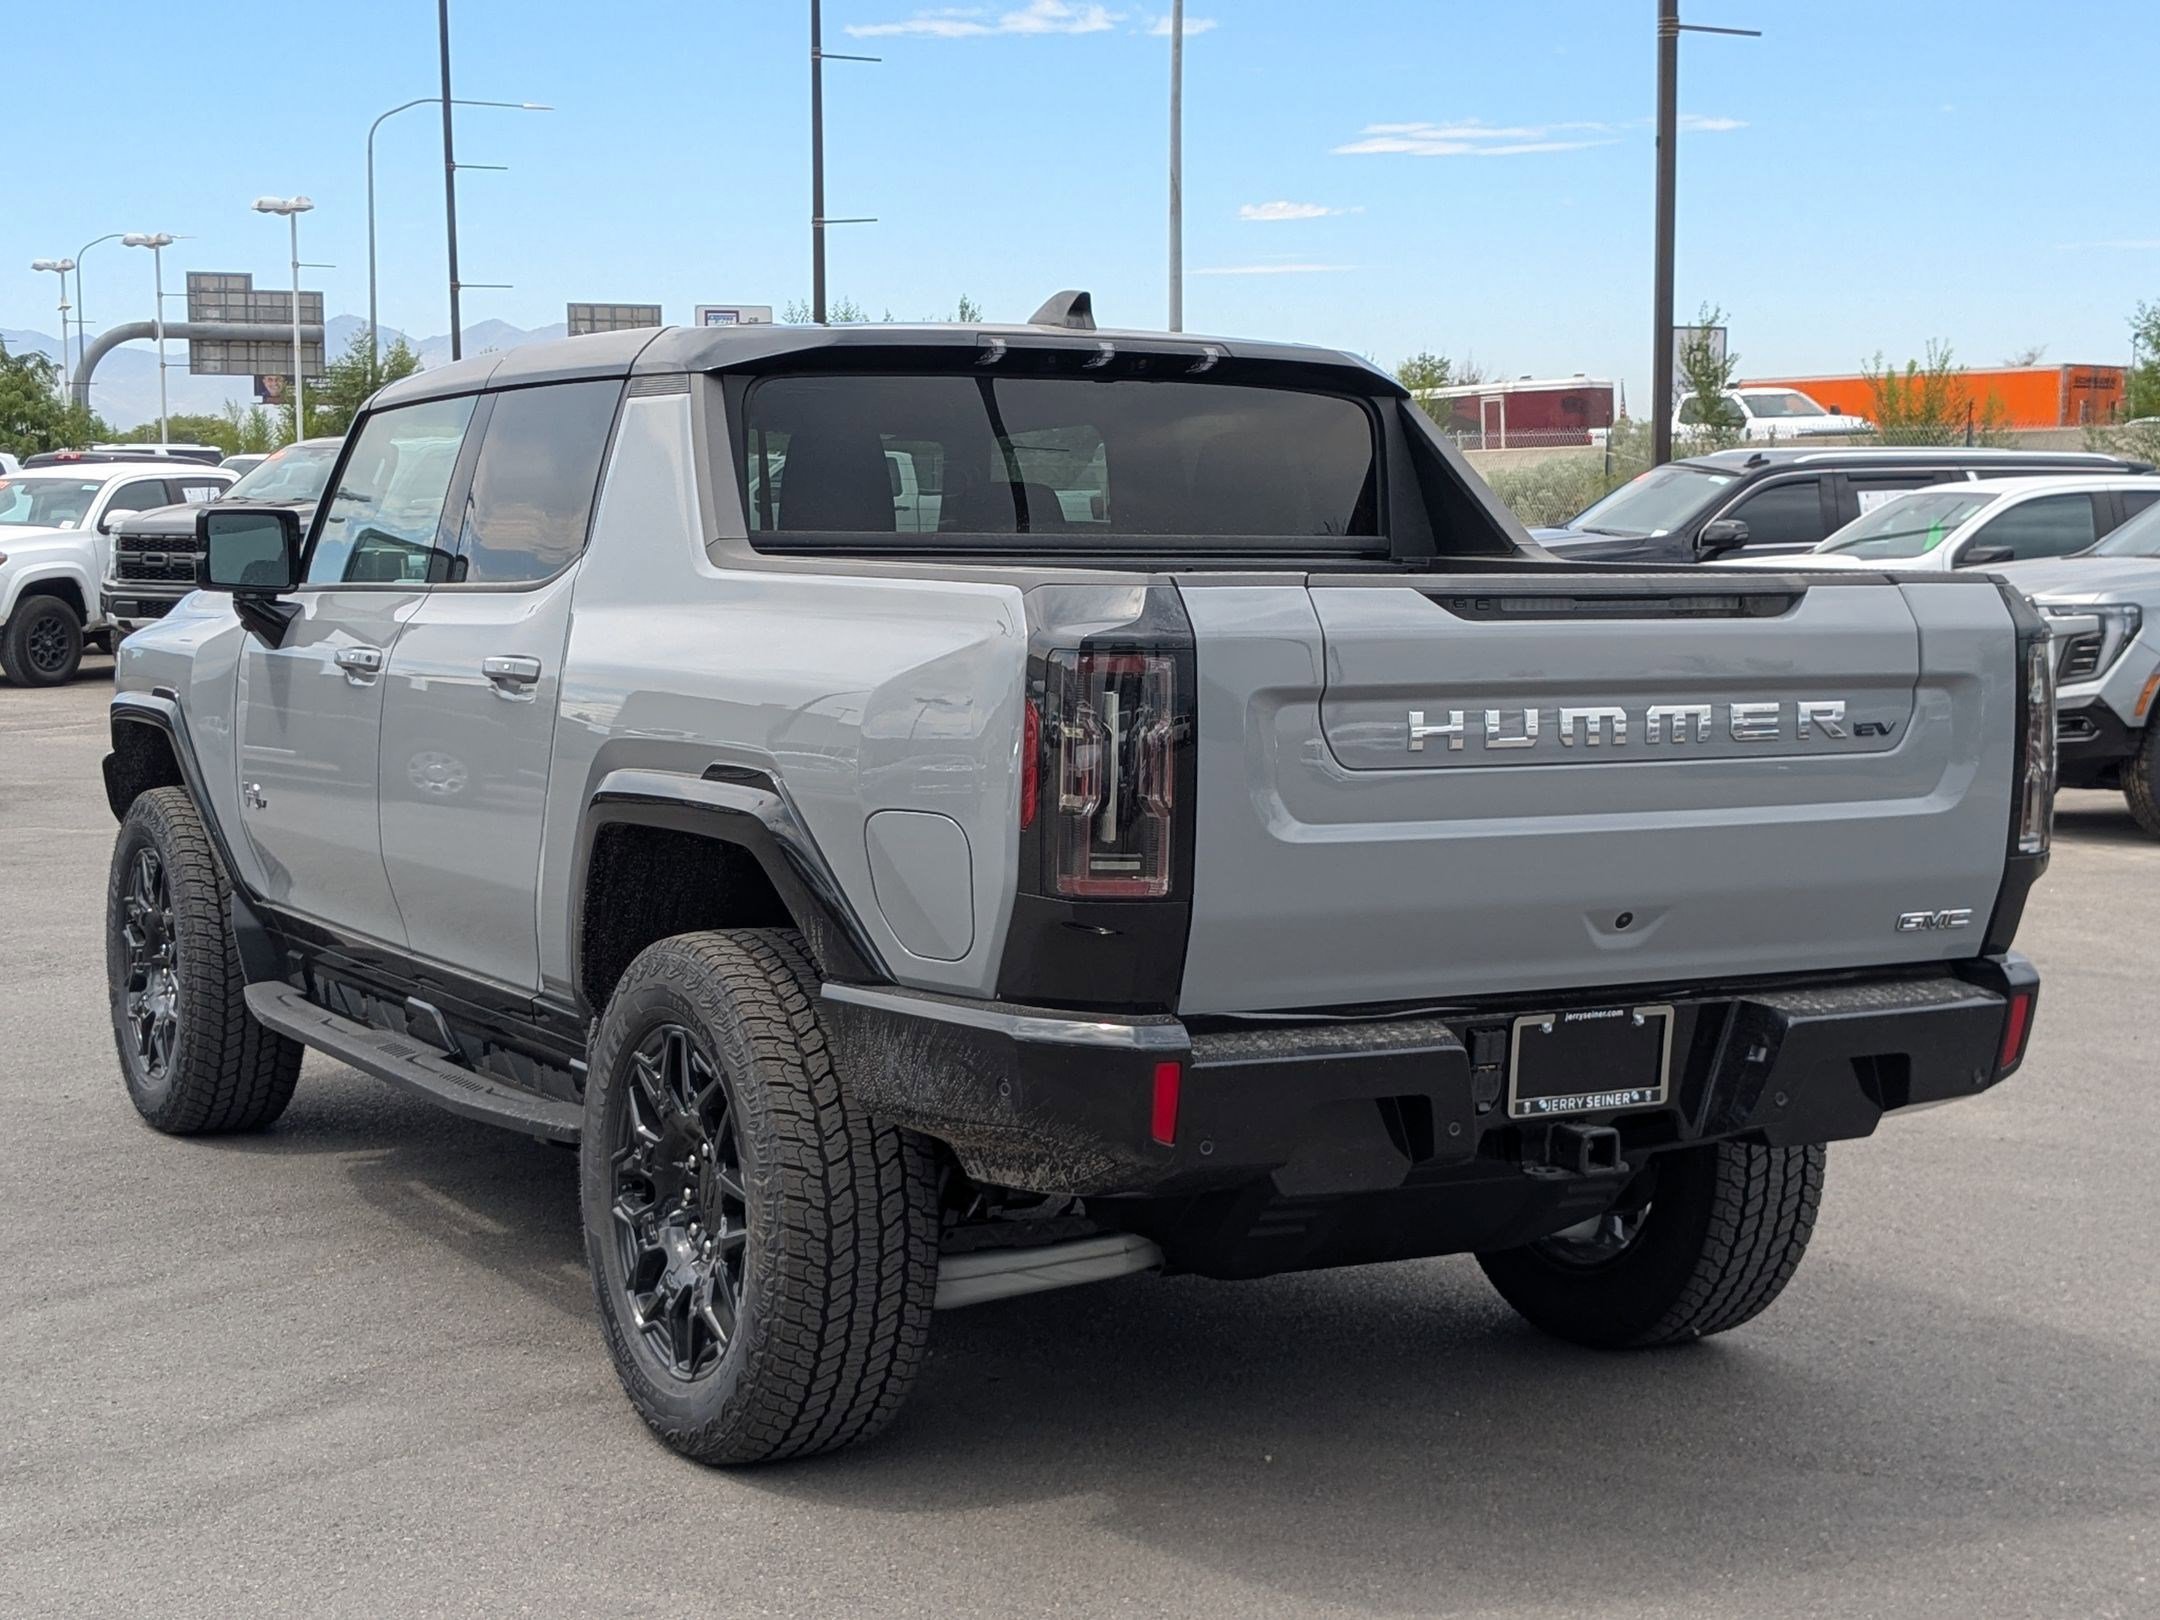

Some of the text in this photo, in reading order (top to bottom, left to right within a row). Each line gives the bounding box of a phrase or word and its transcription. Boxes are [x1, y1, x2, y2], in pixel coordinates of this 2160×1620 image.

[117, 551, 195, 568] FOR
[1407, 700, 1897, 751] HUMMER EV
[1895, 908, 1973, 932] GMC
[1565, 1010, 1624, 1022] jerryseiner.com
[1545, 1093, 1630, 1112] JERRY SEINER
